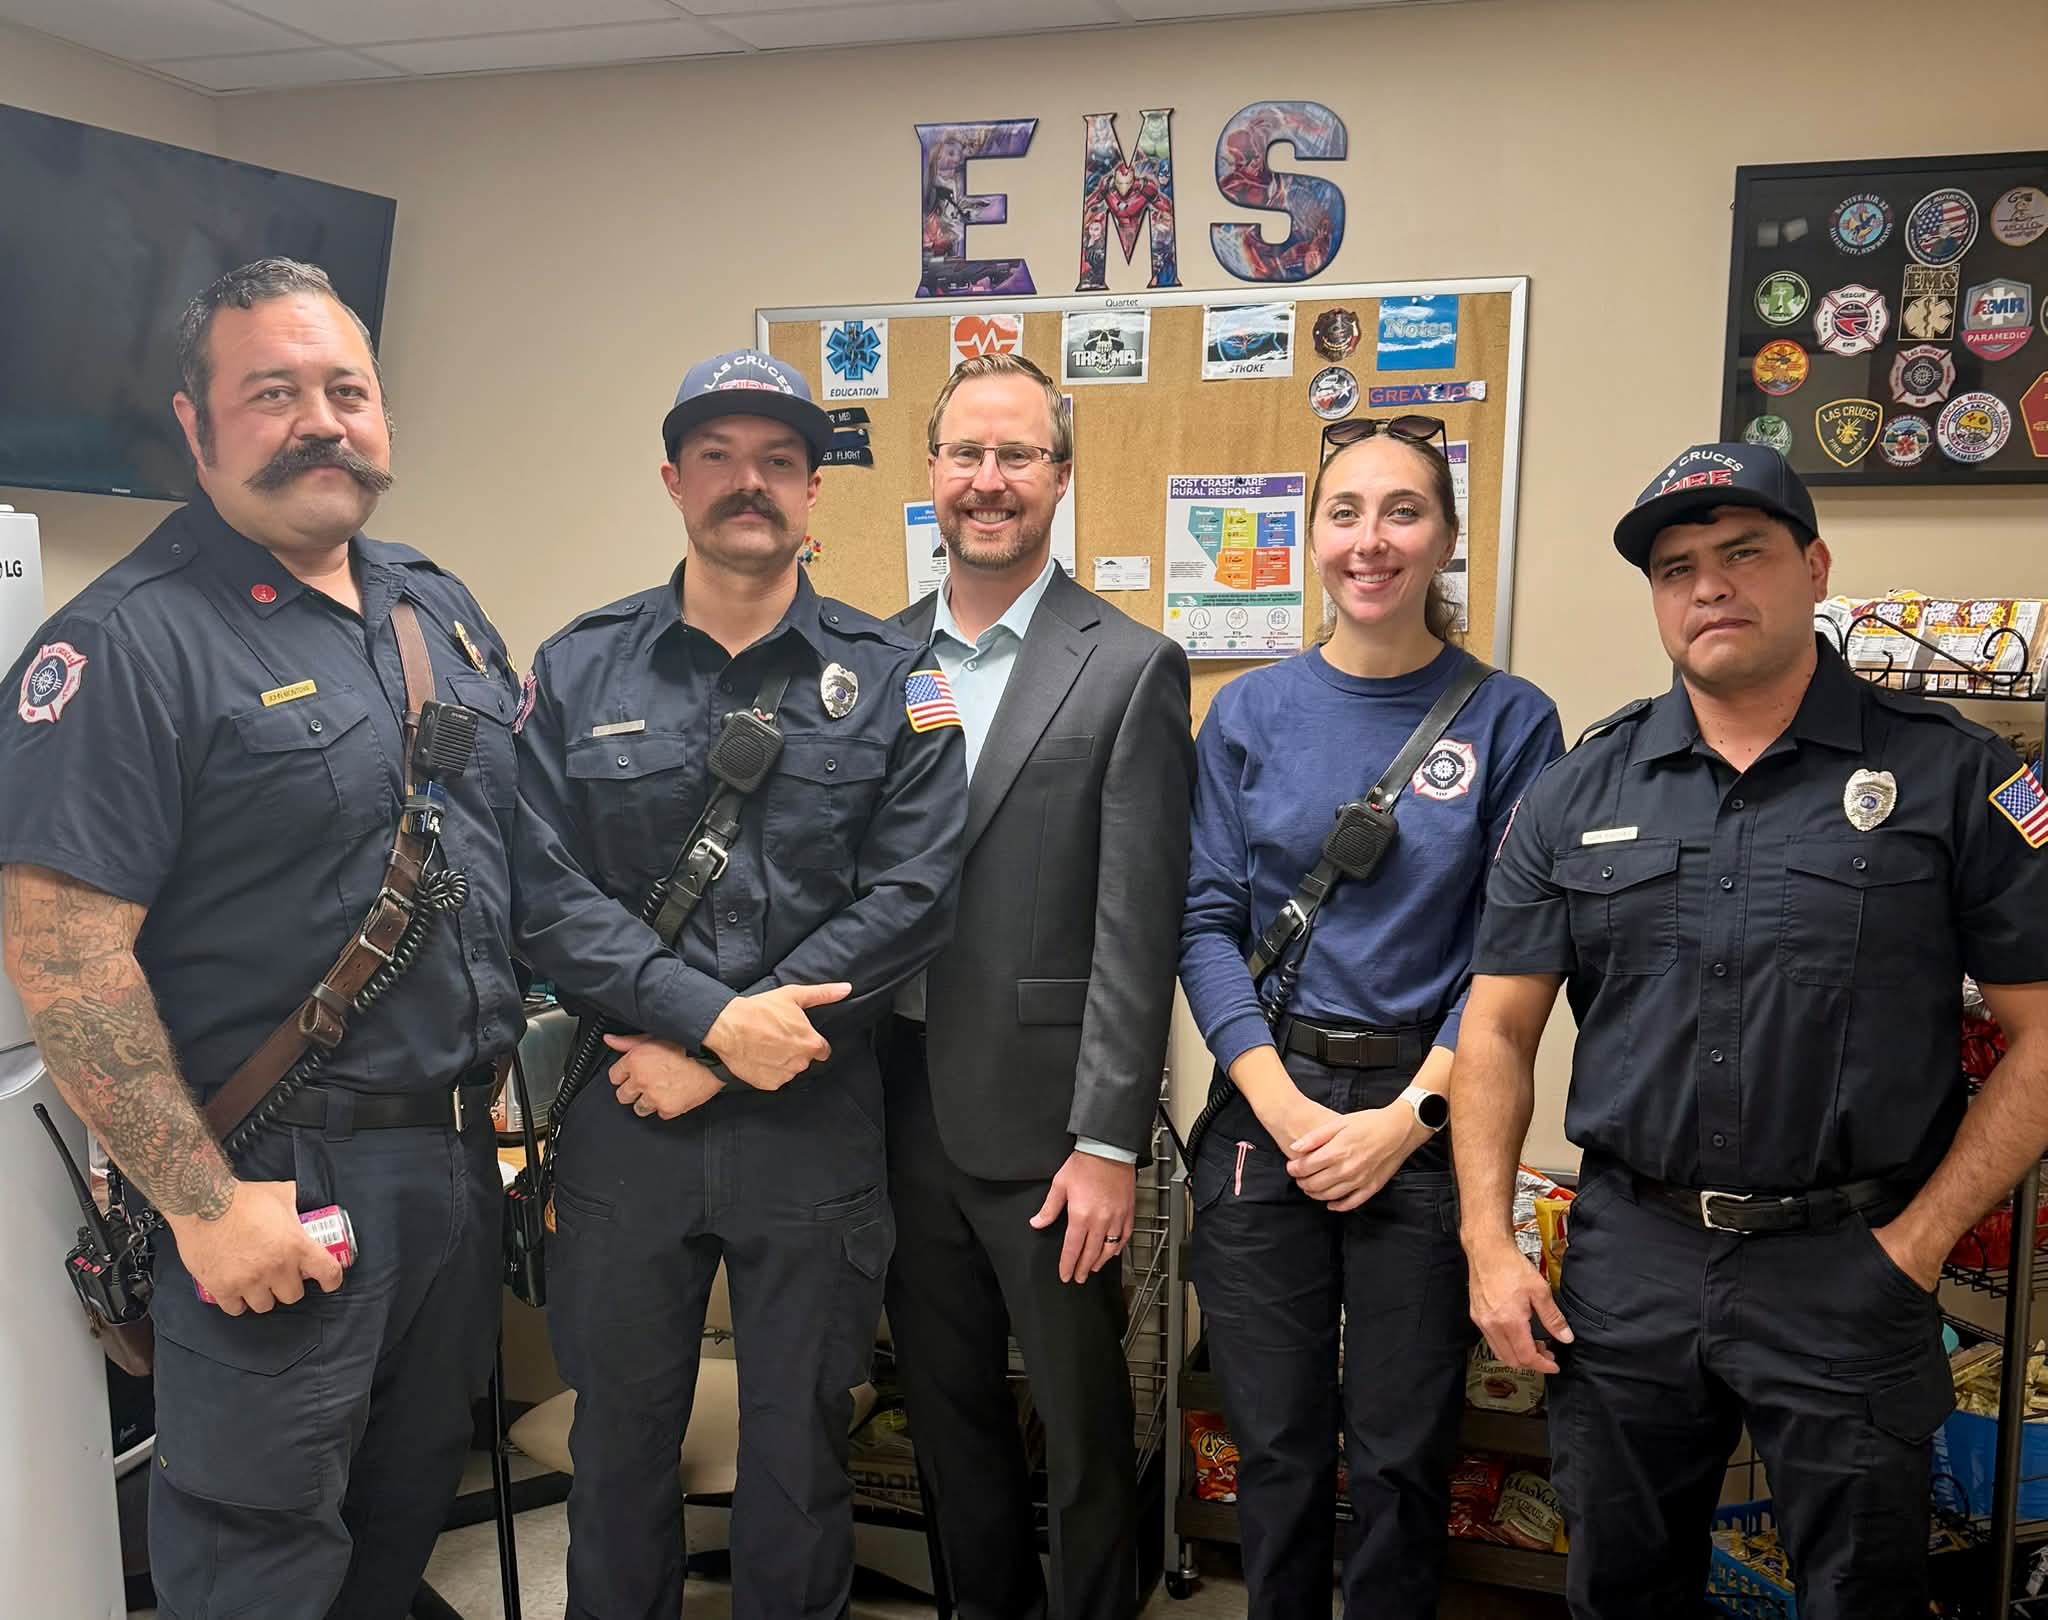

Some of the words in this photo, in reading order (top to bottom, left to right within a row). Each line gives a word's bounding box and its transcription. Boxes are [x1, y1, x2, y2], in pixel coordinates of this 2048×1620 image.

[914, 101, 1348, 298] EMS
[1906, 271, 1960, 289] EMS
[1105, 298, 1139, 307] Quartet
[1383, 319, 1453, 338] Notes
[1967, 331, 2027, 343] PARAMEDIC
[704, 364, 732, 390] LAS
[735, 355, 794, 394] CRUCES
[830, 387, 880, 398] EDUCATION
[1822, 408, 1841, 423] LAS
[1842, 406, 1878, 421] CRUCES
[1939, 400, 1964, 435] AMERICAN
[1967, 394, 2000, 408] MEDICAL
[1827, 438, 1842, 454] FIRE
[1944, 443, 1985, 460] PARAMEDIC
[1679, 450, 1744, 472] CRUCES
[1172, 478, 1200, 488] POST
[1201, 478, 1236, 488] CRASH
[1172, 488, 1206, 497] RURAL
[1208, 486, 1263, 496] RESPONSE
[5, 560, 23, 578] LG
